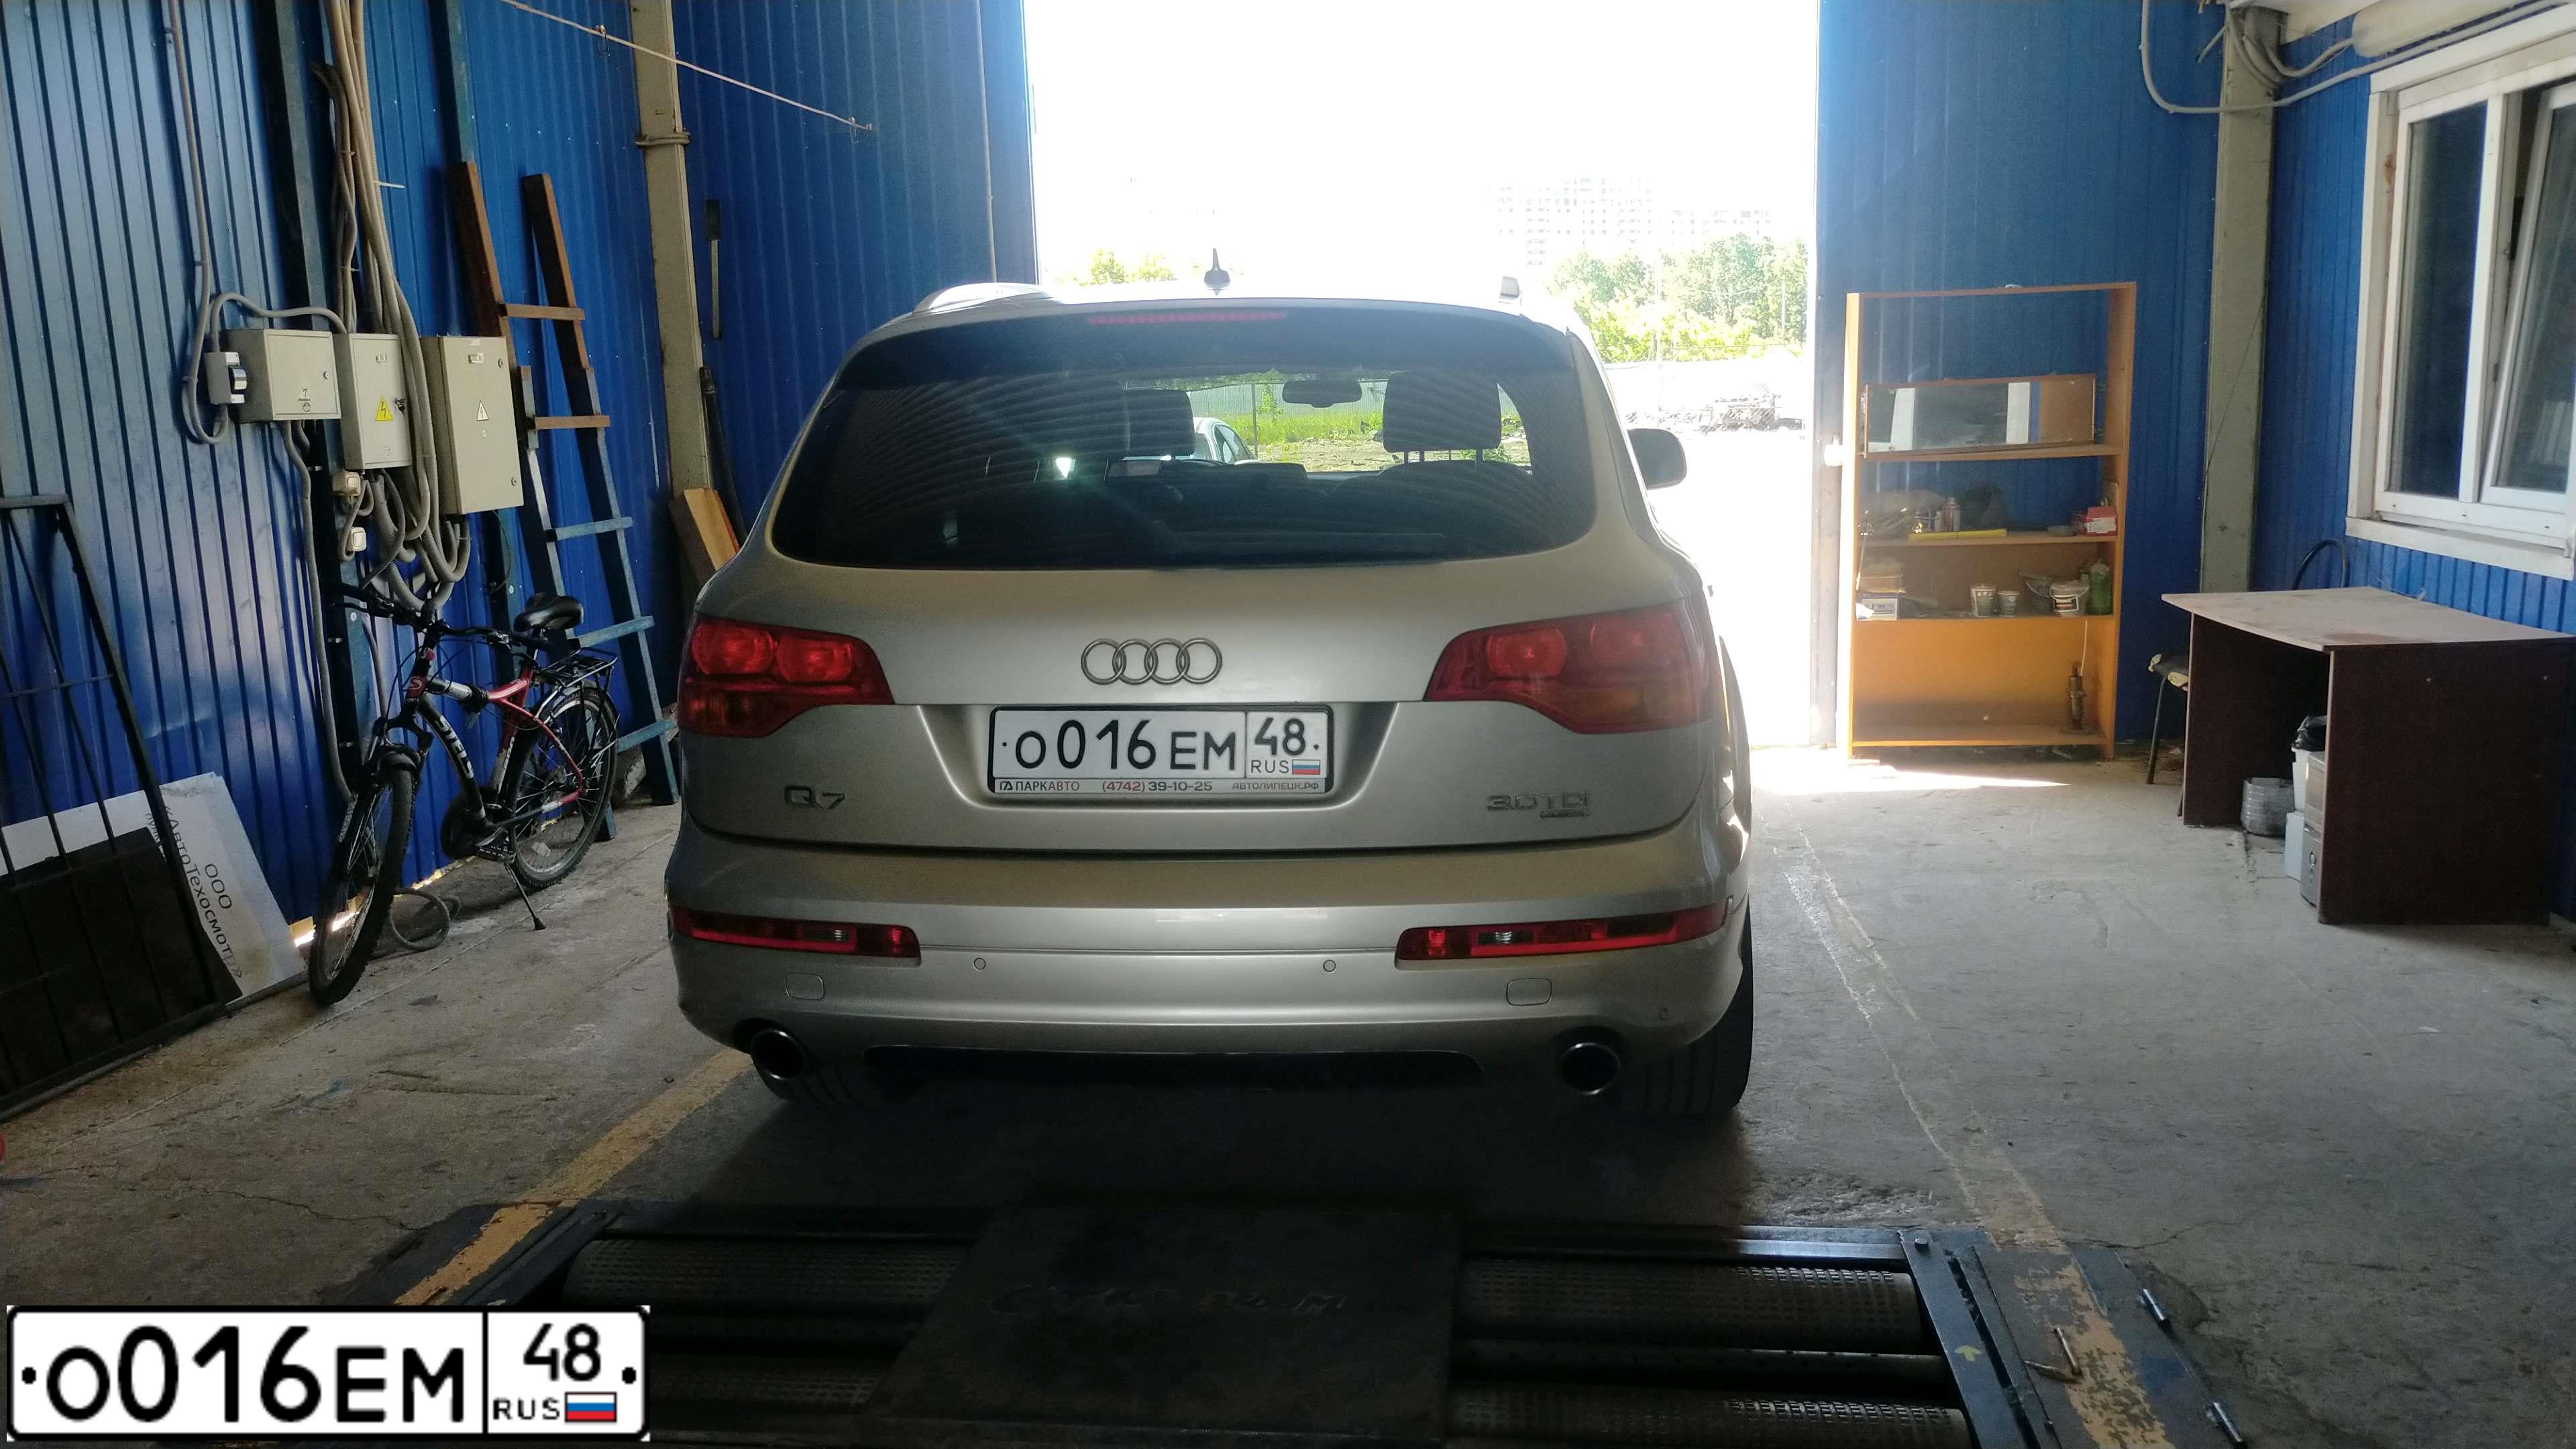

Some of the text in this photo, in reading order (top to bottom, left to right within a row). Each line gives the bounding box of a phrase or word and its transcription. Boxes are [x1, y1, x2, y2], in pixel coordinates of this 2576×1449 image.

[1254, 717, 1305, 756] 48
[1250, 759, 1290, 774] RUS
[784, 785, 846, 810] Q7
[1016, 780, 1320, 793] ПАРКАВТО (4742) 39-10-25 АВТОЛИПЕЦК.РФ
[204, 863, 233, 910] ООО
